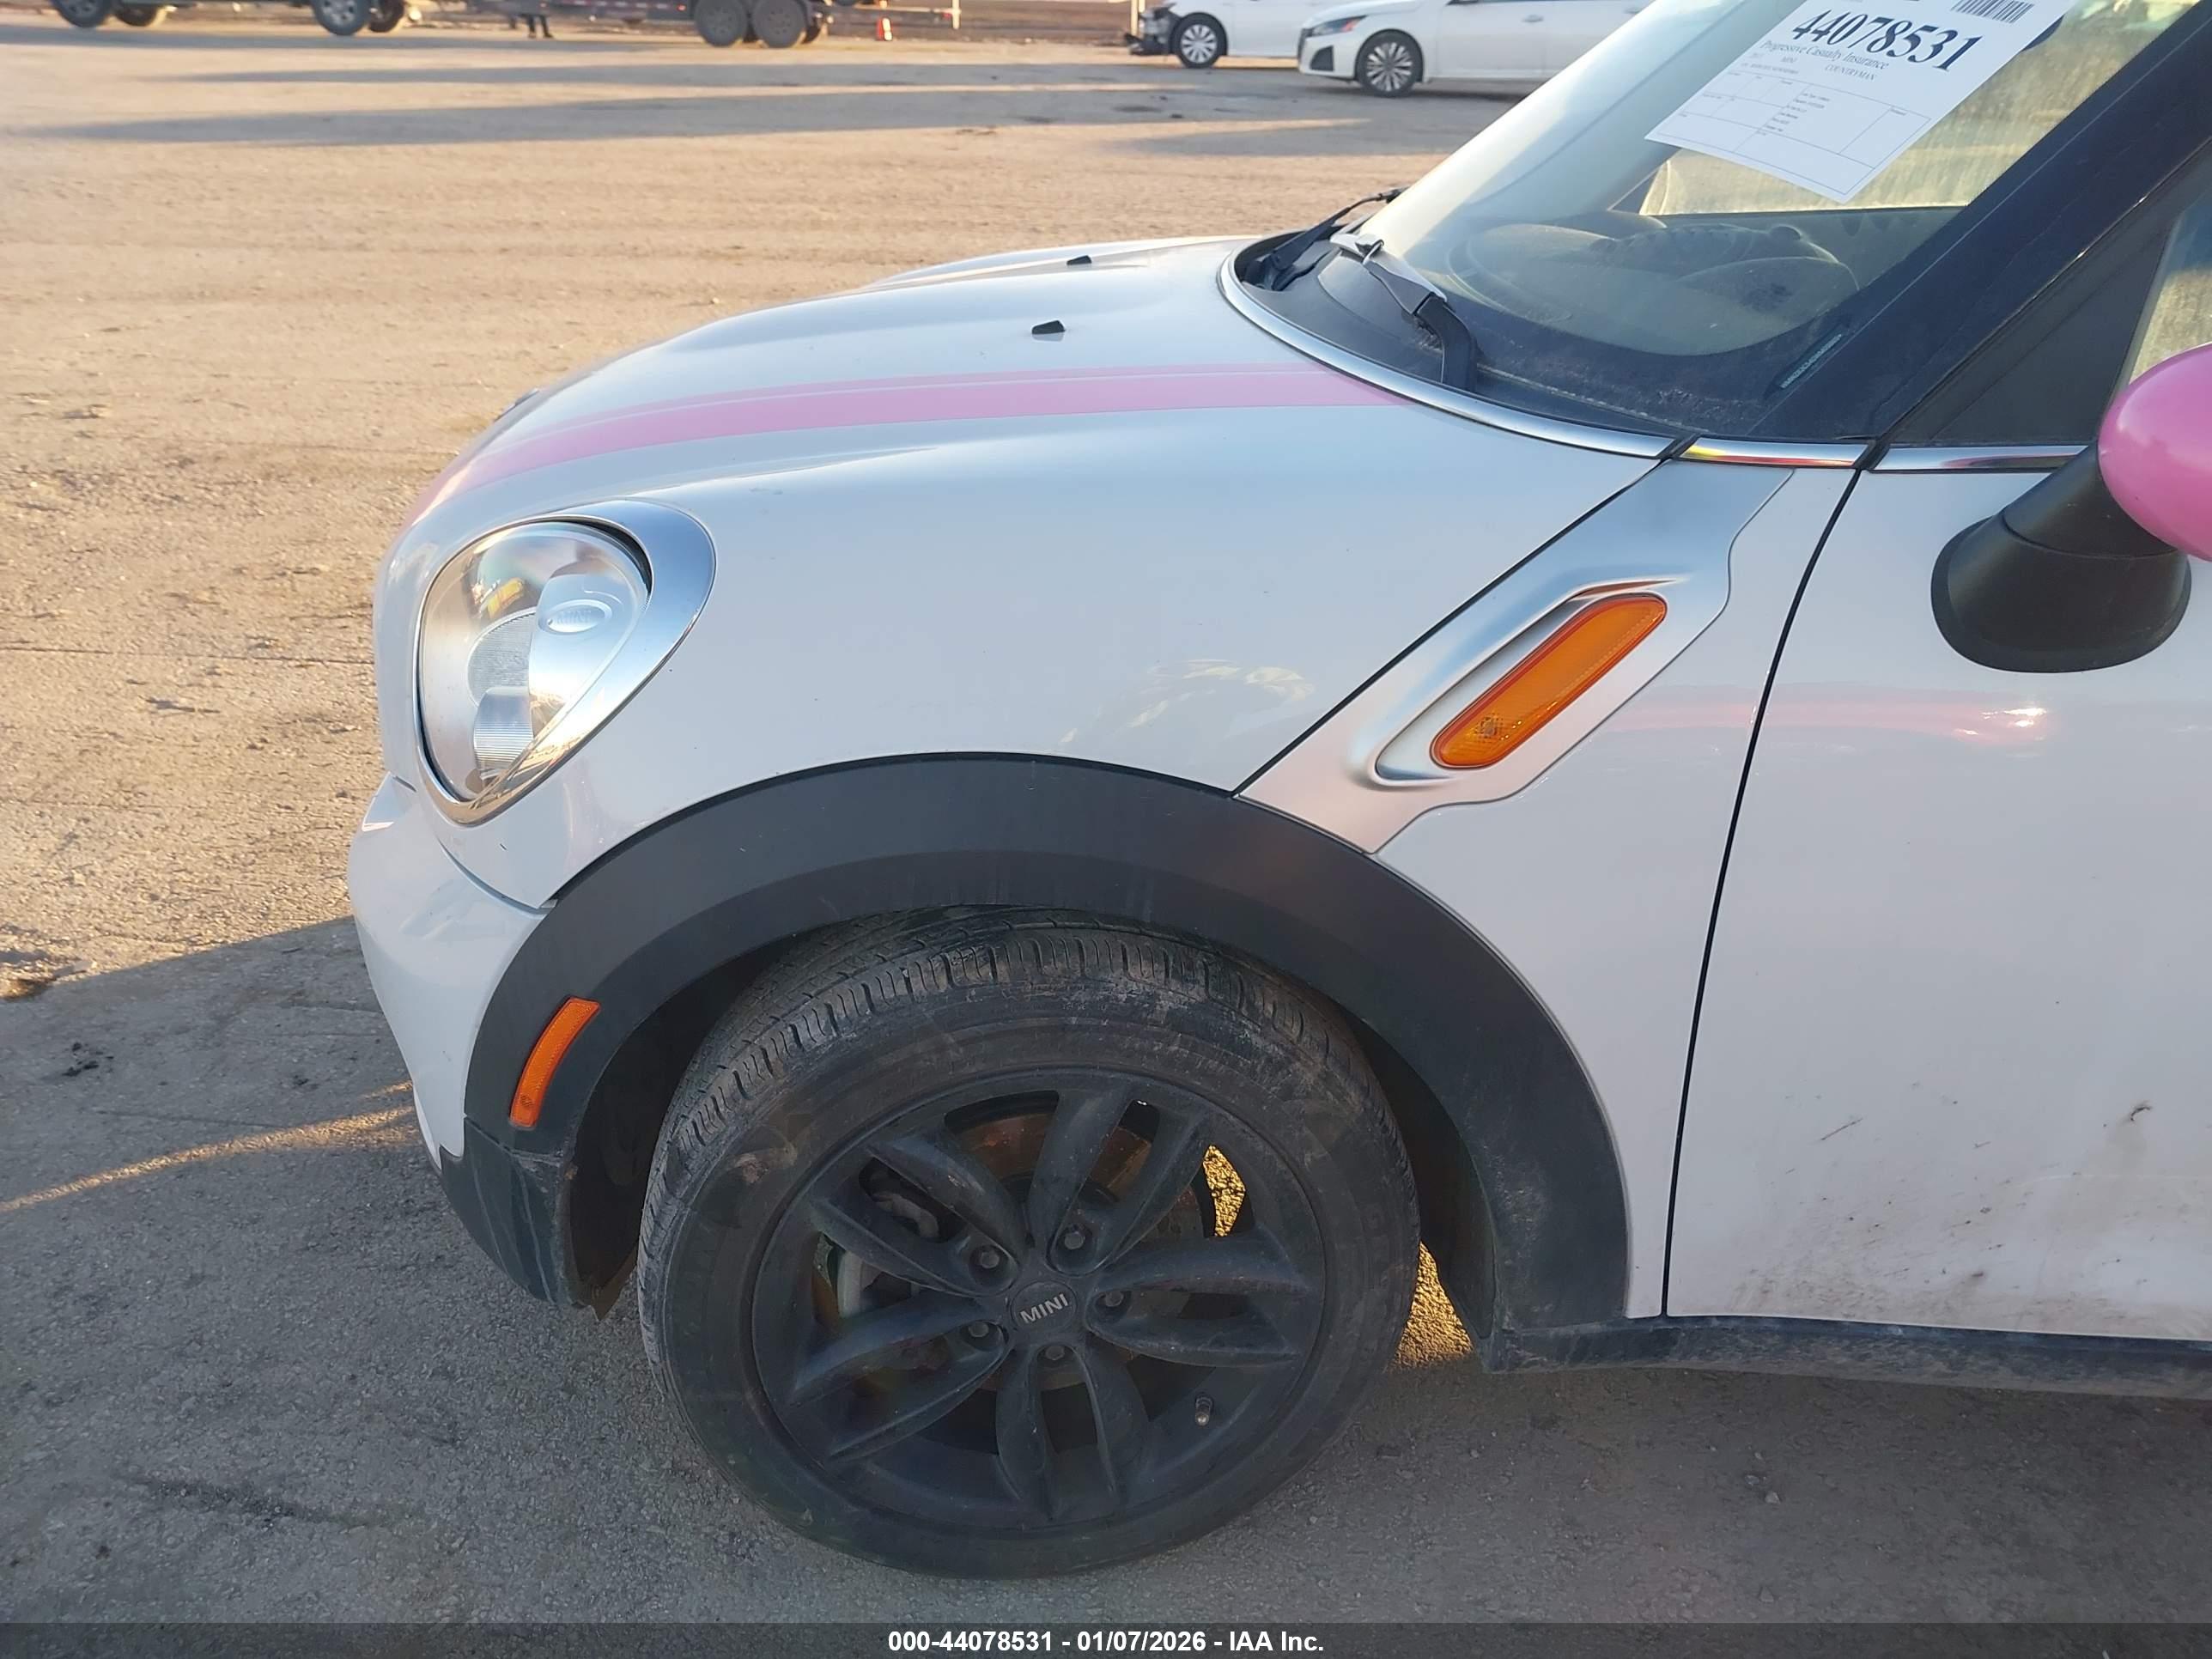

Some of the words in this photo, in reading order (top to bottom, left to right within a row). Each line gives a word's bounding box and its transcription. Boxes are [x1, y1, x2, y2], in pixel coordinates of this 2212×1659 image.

[1792, 9, 1983, 71] 44078531
[1843, 52, 1889, 70] Insurance
[1019, 1293, 1069, 1324] MINI
